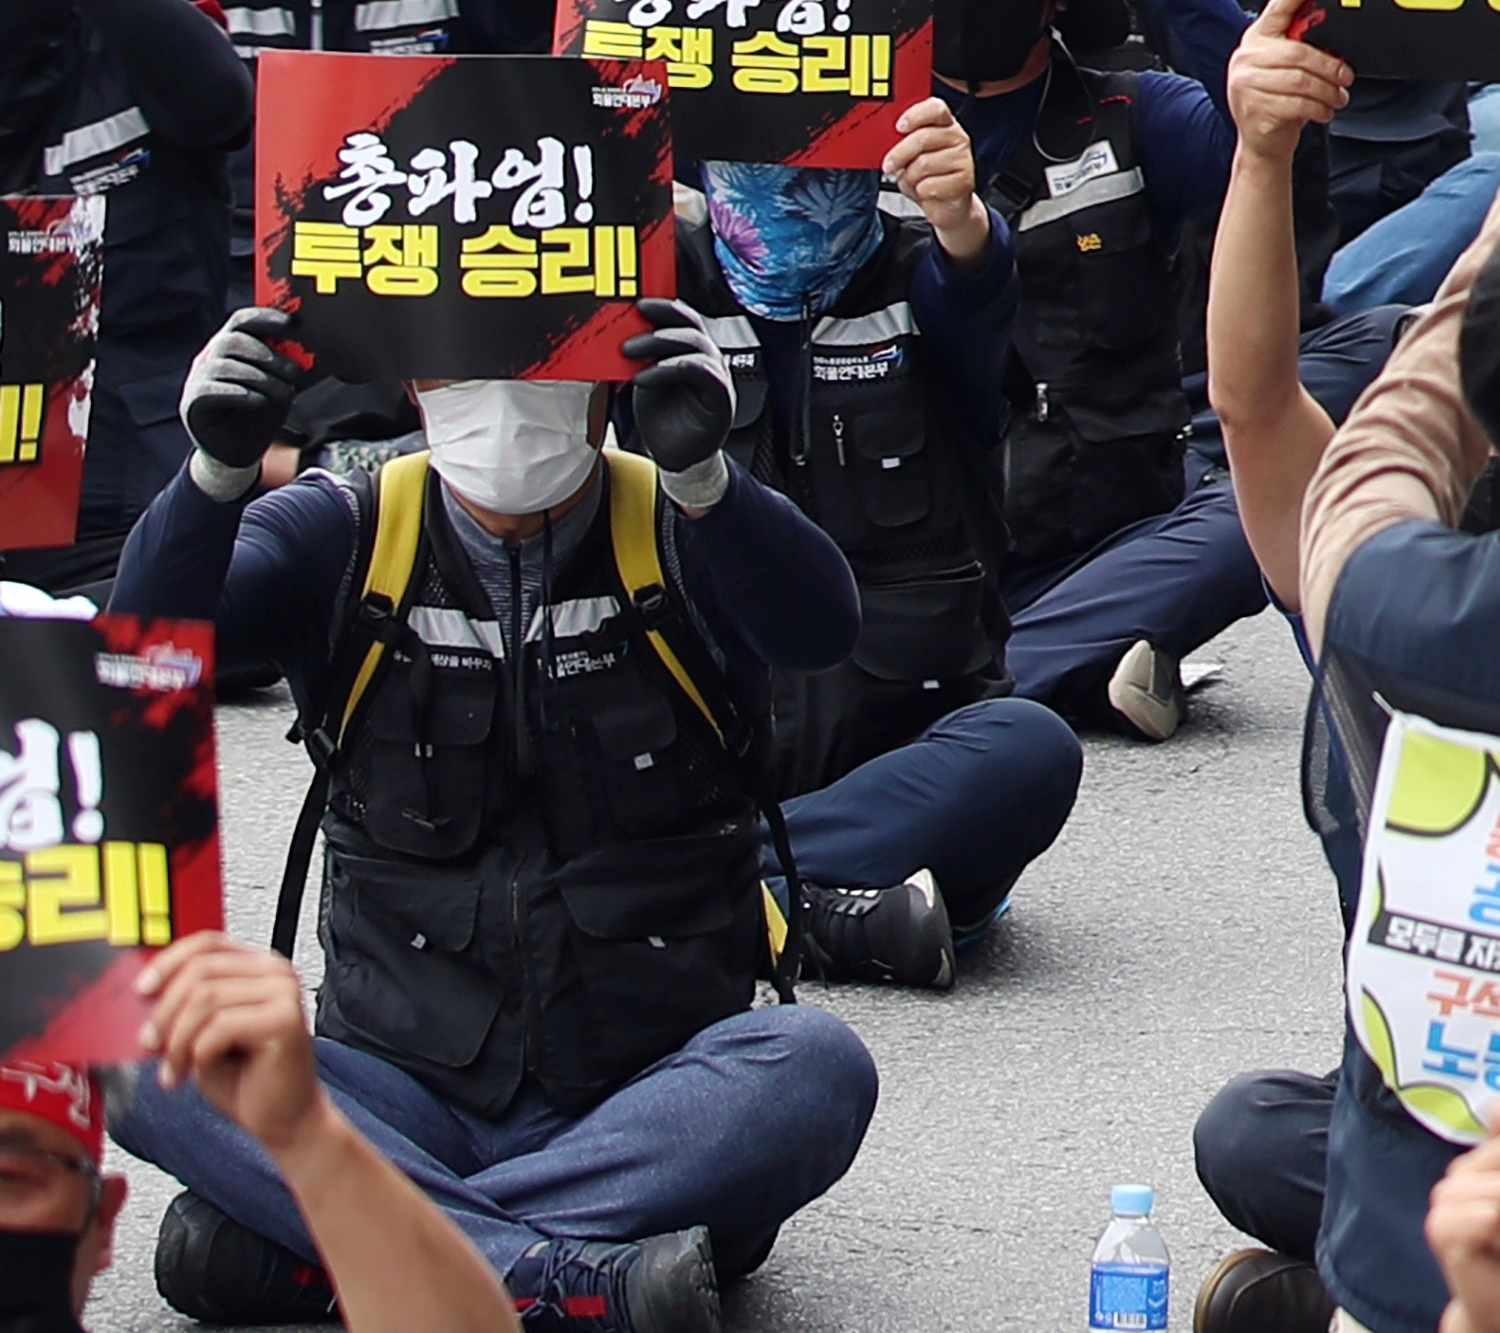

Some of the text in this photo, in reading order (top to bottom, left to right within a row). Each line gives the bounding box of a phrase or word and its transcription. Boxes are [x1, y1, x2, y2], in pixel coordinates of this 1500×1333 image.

[732, 31, 890, 96] 승리!
[324, 134, 592, 227] 총파업!
[294, 222, 636, 297] 투쟁 승리!
[812, 360, 890, 381] 화물연대본부
[1385, 916, 1465, 962] 모두를
